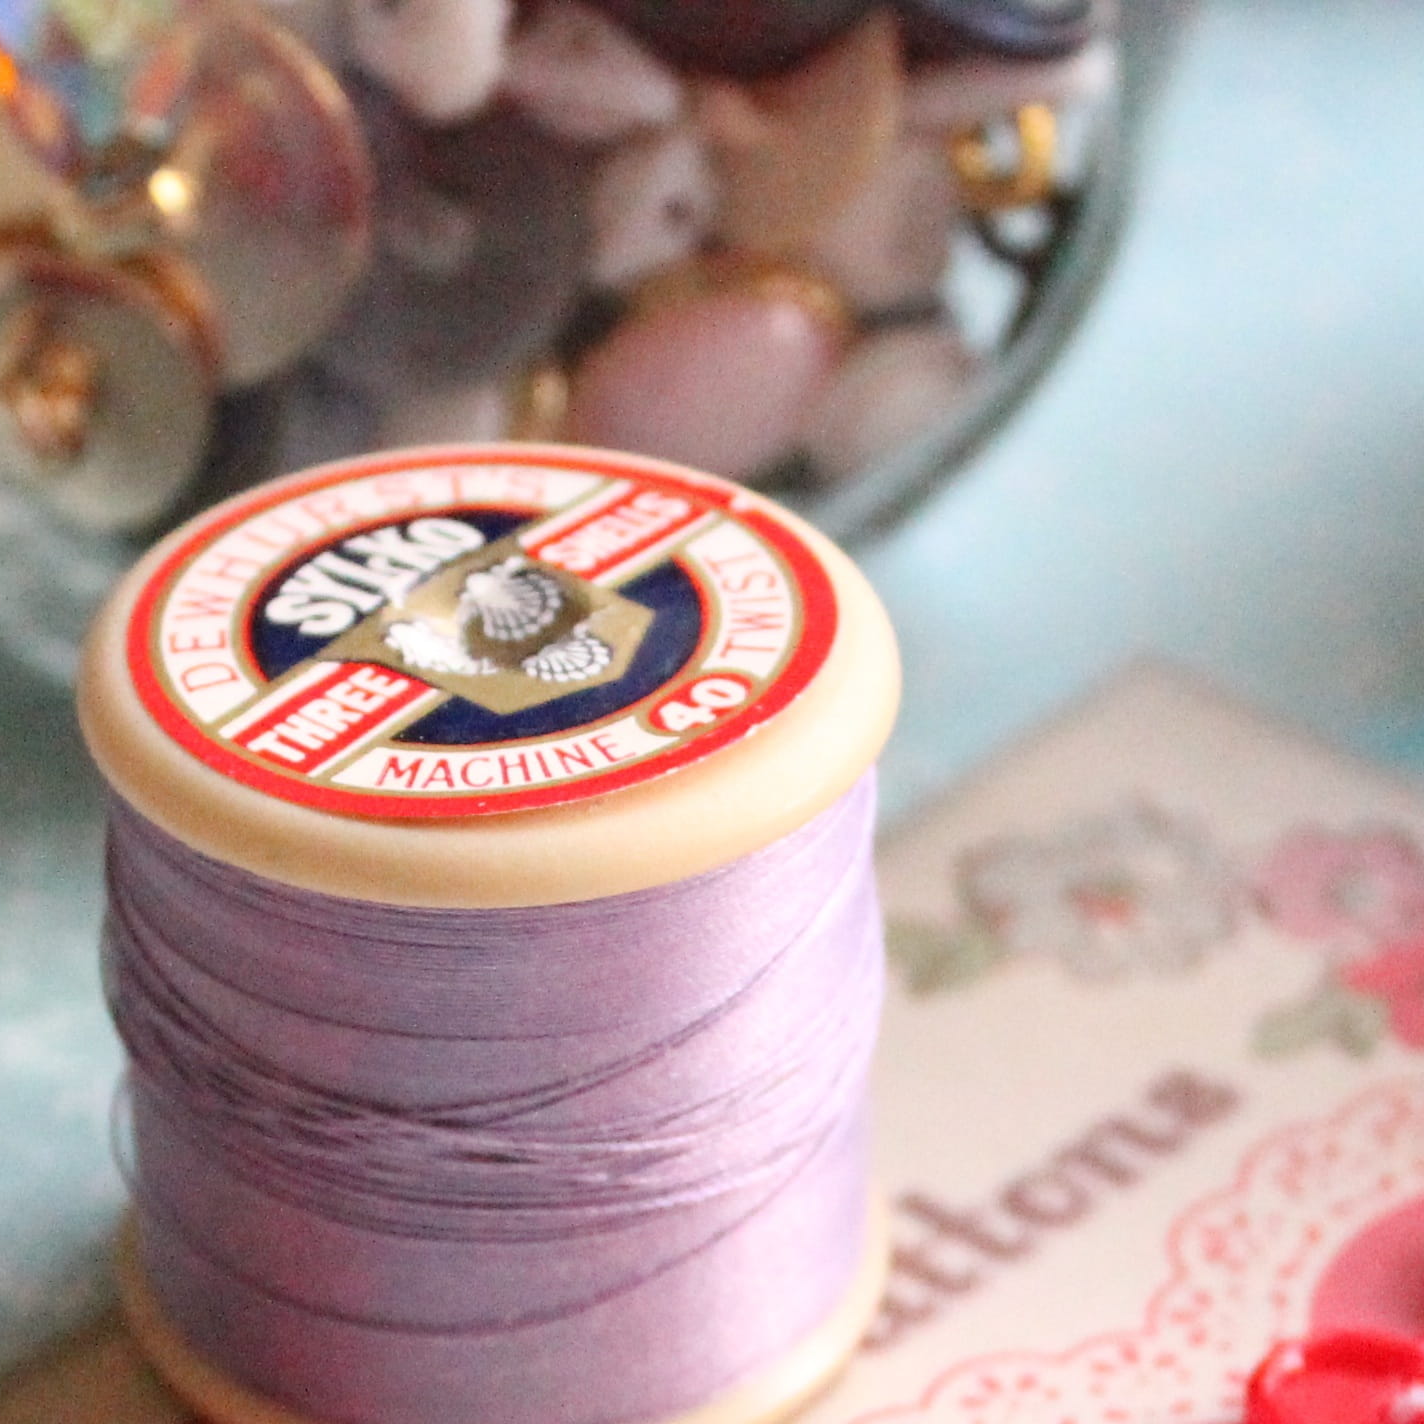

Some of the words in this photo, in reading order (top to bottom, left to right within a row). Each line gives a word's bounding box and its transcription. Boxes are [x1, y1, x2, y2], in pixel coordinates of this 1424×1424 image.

[246, 667, 409, 763] THREE
[376, 732, 637, 788] MACHINE
[658, 678, 747, 731] 40
[706, 552, 785, 658] TWIST
